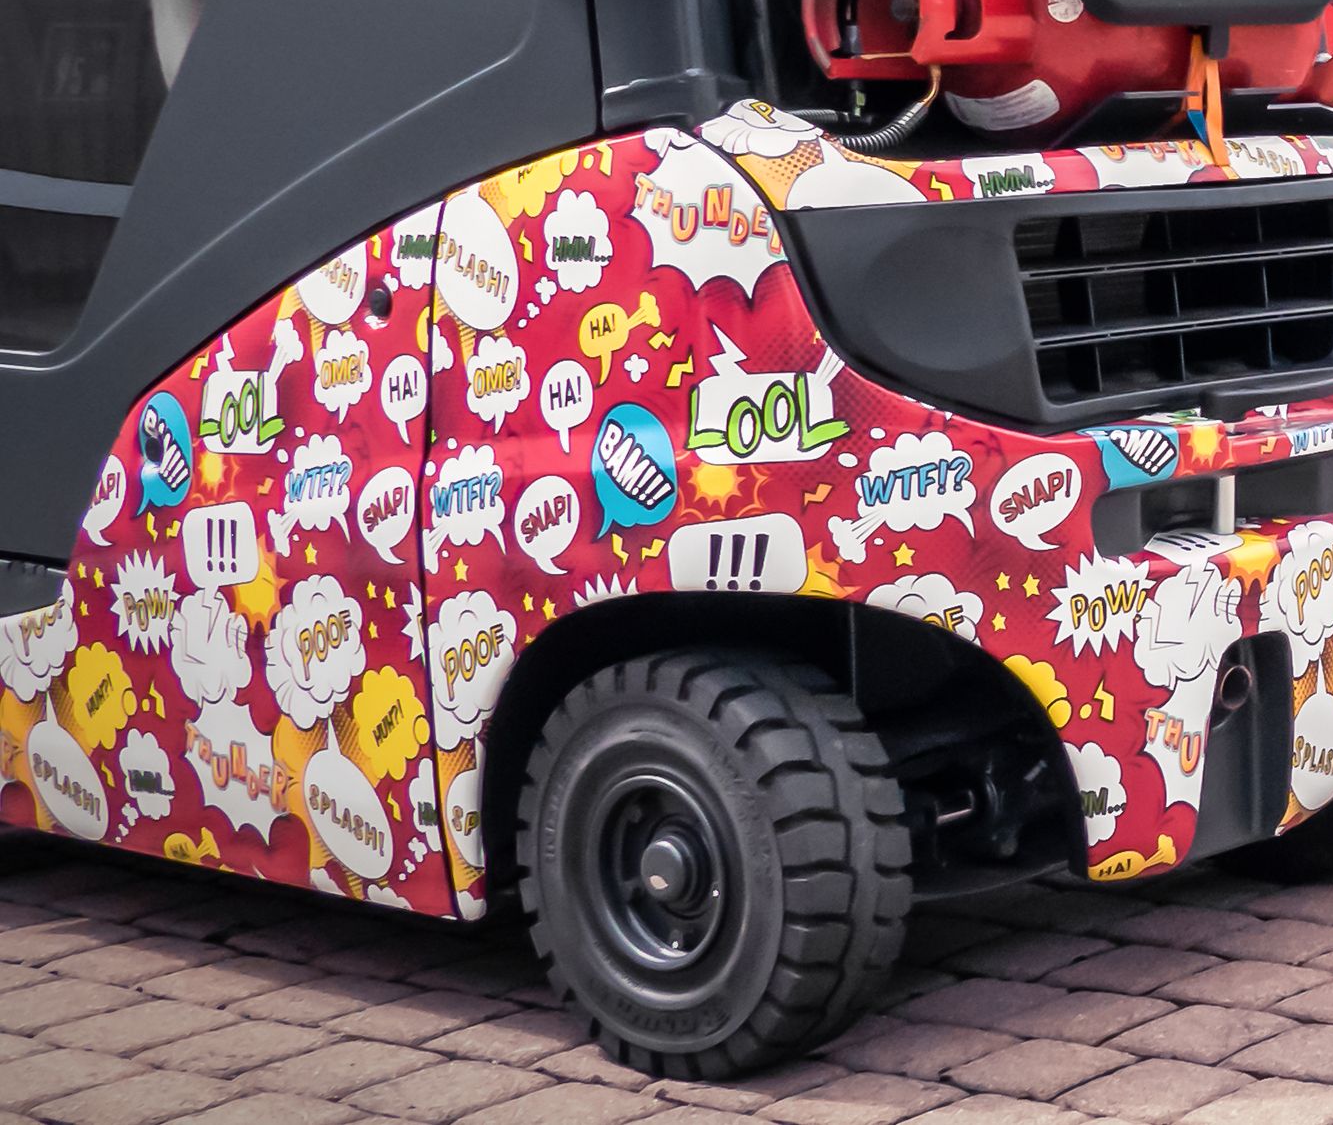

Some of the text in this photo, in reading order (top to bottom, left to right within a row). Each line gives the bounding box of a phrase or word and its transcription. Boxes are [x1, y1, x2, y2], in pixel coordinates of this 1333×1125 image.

[590, 313, 616, 340] HA!
[321, 350, 364, 389] OMG!
[389, 370, 418, 403] HA!
[473, 357, 522, 398] OMG!
[548, 376, 582, 411] HA!
[686, 371, 851, 458] LOOL
[289, 461, 351, 503] WTF!?
[598, 420, 674, 509] BAM!!!
[861, 456, 971, 506] WTF!?
[363, 485, 409, 532] SNAP!
[433, 472, 503, 518] WTF!?
[520, 493, 572, 543] SNAP!
[999, 469, 1073, 523] SNAP!
[207, 518, 237, 573] !!!
[706, 533, 770, 591] !!!
[123, 587, 177, 633] POW!
[1070, 579, 1147, 632] POW!
[300, 609, 351, 681] POOF
[444, 623, 504, 702] POOF
[32, 752, 101, 822] SPLASH!
[309, 783, 385, 857] SPLASH!
